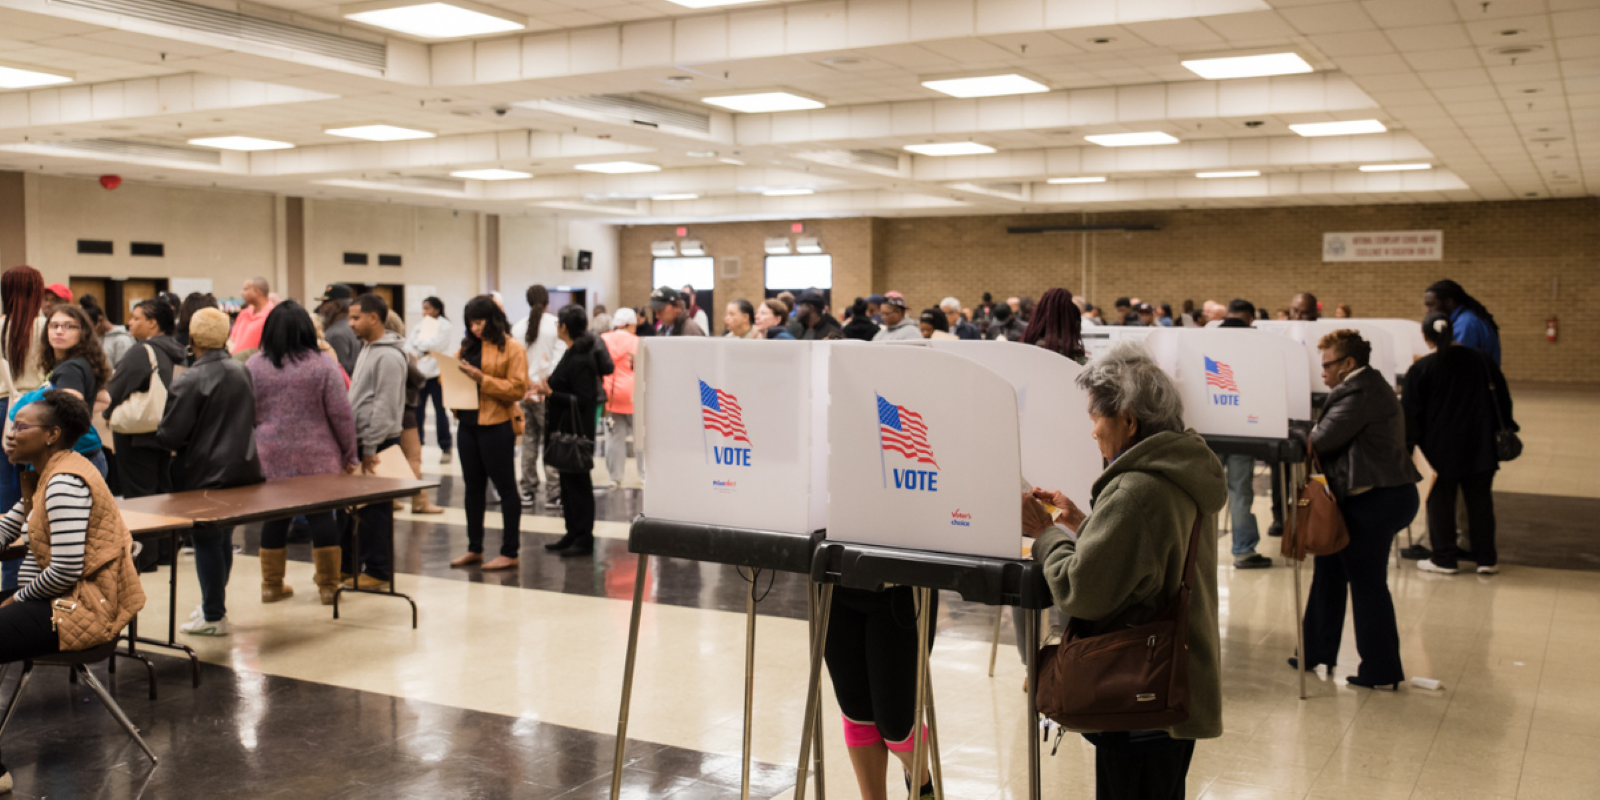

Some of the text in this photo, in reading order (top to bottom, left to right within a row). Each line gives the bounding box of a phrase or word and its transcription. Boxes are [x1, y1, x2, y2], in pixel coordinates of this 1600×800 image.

[1213, 393, 1240, 406] VOTE
[713, 445, 752, 467] VOTE
[893, 468, 938, 492] VOTE
